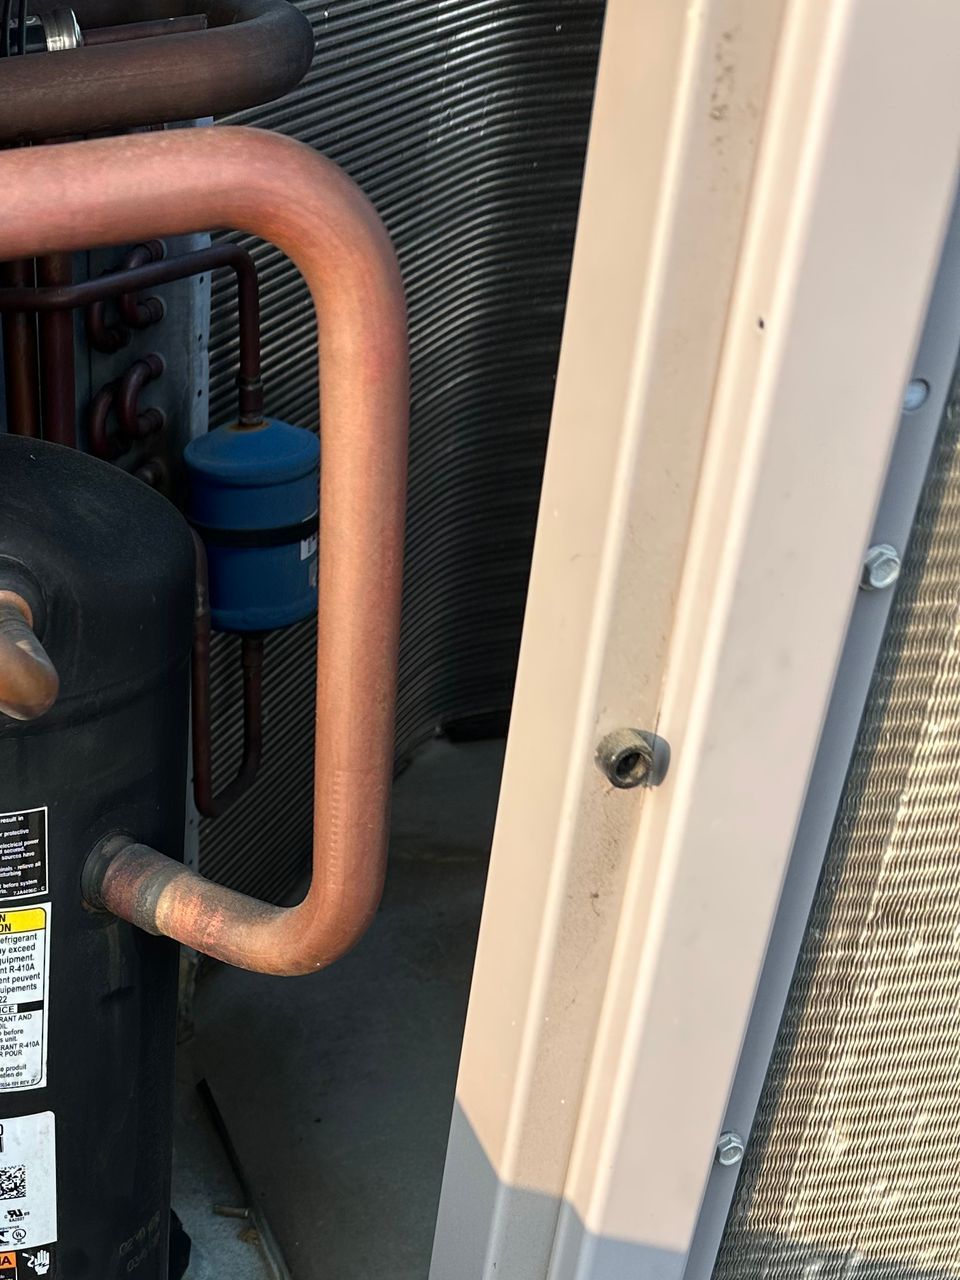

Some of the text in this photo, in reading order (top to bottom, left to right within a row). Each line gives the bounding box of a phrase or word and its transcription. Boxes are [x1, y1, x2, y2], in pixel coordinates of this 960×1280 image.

[9, 943, 35, 952] exceed
[9, 963, 35, 973] R-410A
[12, 972, 40, 984] peuvent
[6, 1064, 26, 1072] produit
